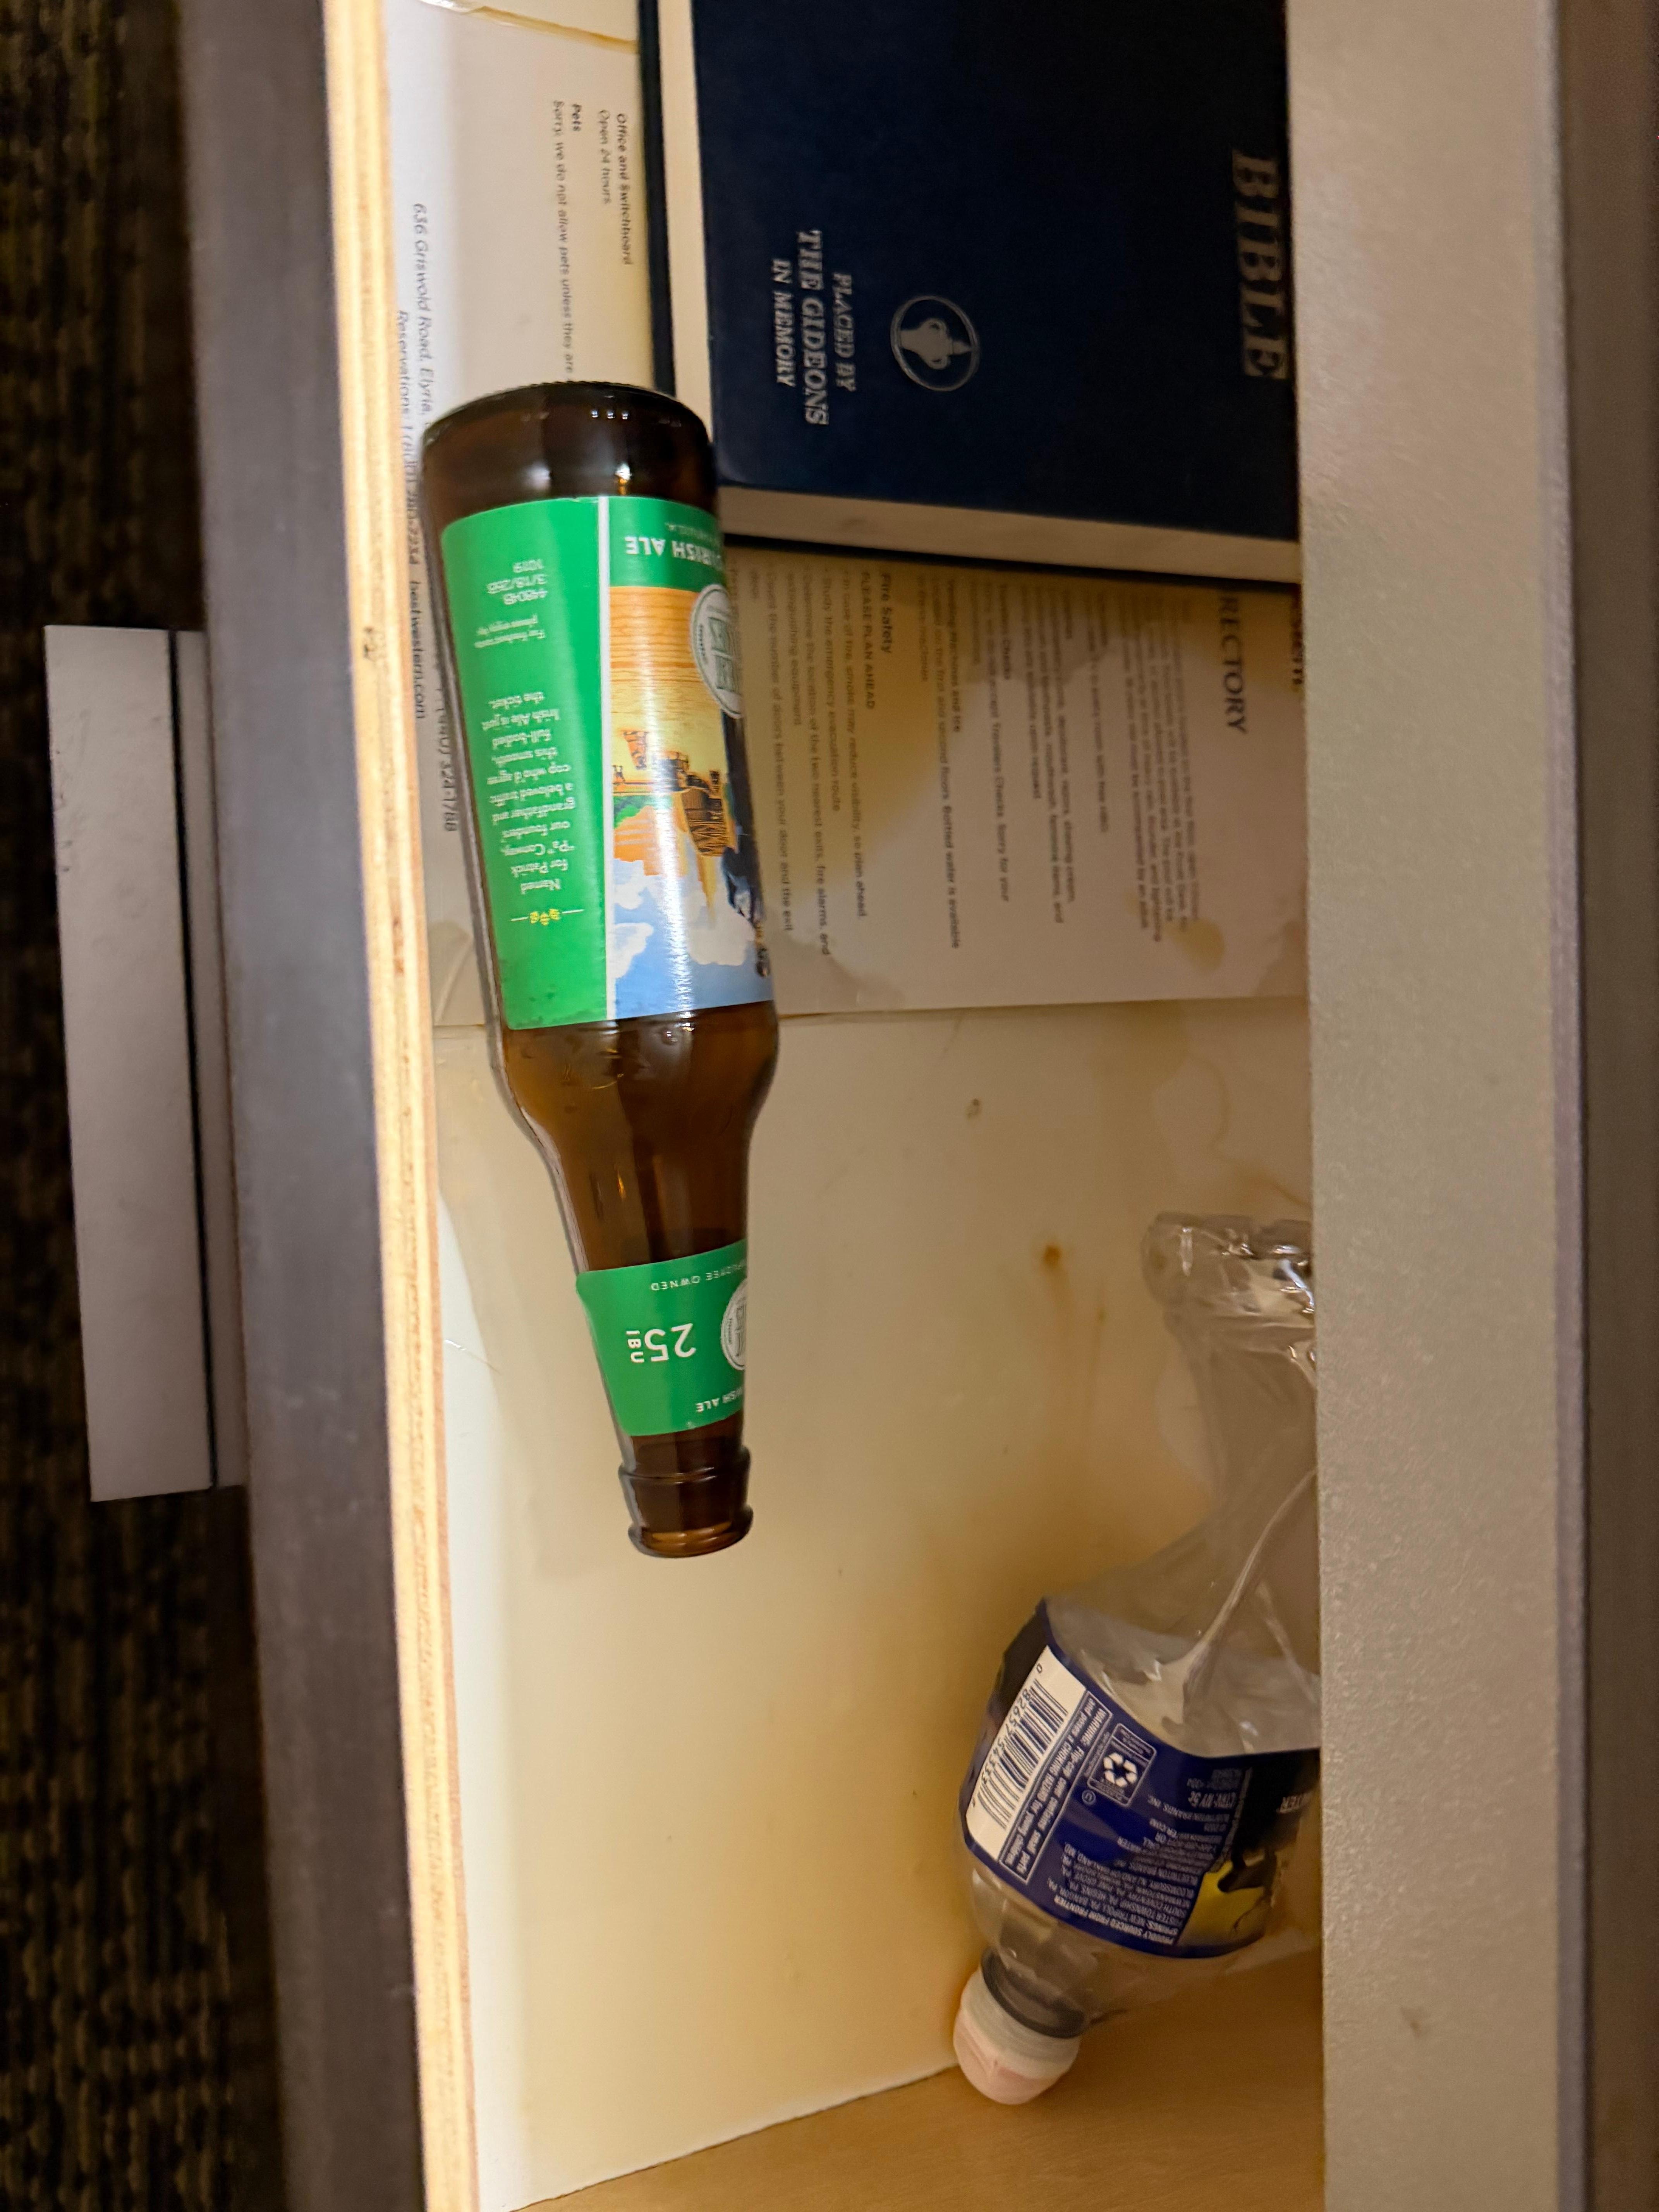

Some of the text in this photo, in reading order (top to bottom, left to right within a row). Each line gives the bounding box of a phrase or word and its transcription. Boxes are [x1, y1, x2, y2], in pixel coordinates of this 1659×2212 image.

[570, 103, 583, 132] Pets
[554, 142, 565, 160] we
[597, 110, 612, 204] Open 24 hours
[556, 164, 567, 181] do
[556, 184, 568, 205] not
[616, 113, 632, 265] Office and Switchboard
[412, 203, 428, 235] 636
[557, 210, 570, 242] allow
[558, 246, 571, 275] pets
[1231, 146, 1290, 380] BIBLE
[414, 240, 431, 312] Griswold
[561, 278, 574, 318] unless
[769, 257, 799, 388] IN MEMORY
[795, 229, 831, 426] THE GIDEONS
[830, 272, 858, 393] PLACED BY
[561, 323, 575, 349] they
[565, 354, 575, 373] are
[625, 536, 665, 557] ALE
[878, 574, 895, 654] Fire Safety
[409, 581, 428, 720] bestwestern.com
[860, 572, 876, 710] PLEASE PLAN AHEAD
[1218, 595, 1249, 736] RECTORY
[522, 691, 545, 705] the
[500, 716, 510, 728] is
[510, 713, 531, 726] Ale
[531, 708, 559, 723] Irish
[491, 728, 551, 750] full-bodied
[534, 746, 557, 761] this
[848, 737, 860, 778] reduce
[547, 760, 572, 774] cop
[519, 784, 563, 802] beloved
[564, 782, 573, 791] a
[491, 797, 576, 825] grandfather and
[549, 821, 570, 830] our
[510, 858, 568, 878] for Patrick
[853, 852, 864, 878] plan
[520, 878, 561, 895] Named
[649, 1274, 701, 1291] OWNED
[625, 1328, 644, 1364] IBU
[642, 1322, 697, 1362] 25
[694, 1397, 721, 1412] ALE
[1082, 1697, 1098, 1716] and
[1068, 1711, 1089, 1737] poses
[1079, 1707, 1108, 1748] WARNING:
[1047, 1741, 1074, 1777] CHOKING
[1061, 1745, 1086, 1779] Flip-cap
[1034, 1772, 1057, 1802] HAZARD
[1028, 1799, 1043, 1815] for
[1034, 1796, 1060, 1831] contains
[1015, 1810, 1036, 1836] young
[1024, 1830, 1044, 1854] small
[1014, 1851, 1033, 1874] parts
